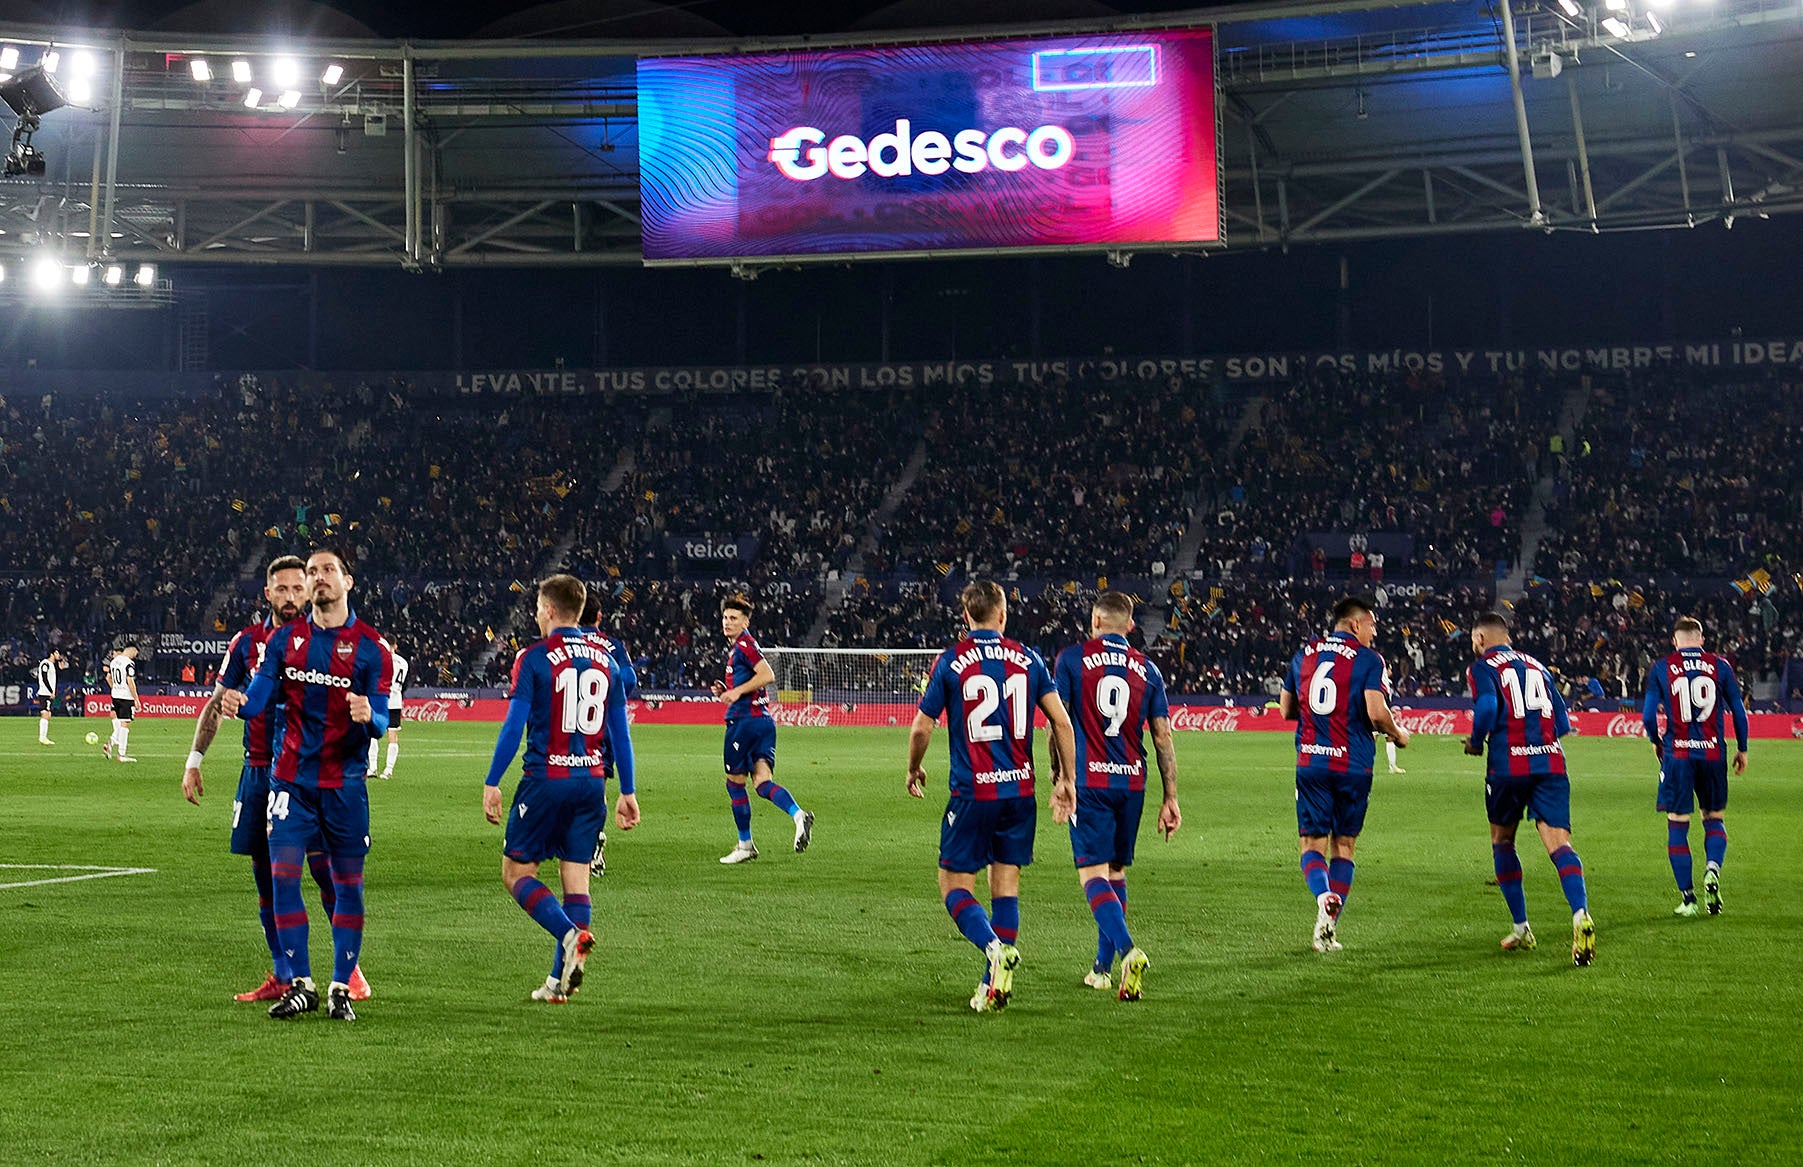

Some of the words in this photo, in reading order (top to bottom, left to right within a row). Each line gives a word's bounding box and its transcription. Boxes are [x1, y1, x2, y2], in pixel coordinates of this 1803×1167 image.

[768, 119, 1076, 182] Gedesco
[594, 371, 646, 391] TUS
[655, 368, 781, 391] COLORES
[861, 365, 914, 387] LOS
[1225, 356, 1288, 378] SON
[1455, 351, 1474, 371] Y
[1485, 350, 1525, 372] TU
[1685, 343, 1719, 365] MI
[110, 667, 122, 685] 10
[285, 666, 351, 690] Gedesco
[545, 647, 567, 666] DE
[564, 644, 610, 668] FRUTOS
[950, 646, 984, 675] DANI
[1082, 652, 1127, 671] ROGER
[143, 701, 197, 716] Santander
[555, 667, 609, 735] 18
[962, 673, 1003, 743] 21
[1096, 675, 1130, 737] 9
[1308, 660, 1337, 716] 6
[1500, 668, 1553, 719] 14
[1671, 675, 1716, 723] 19
